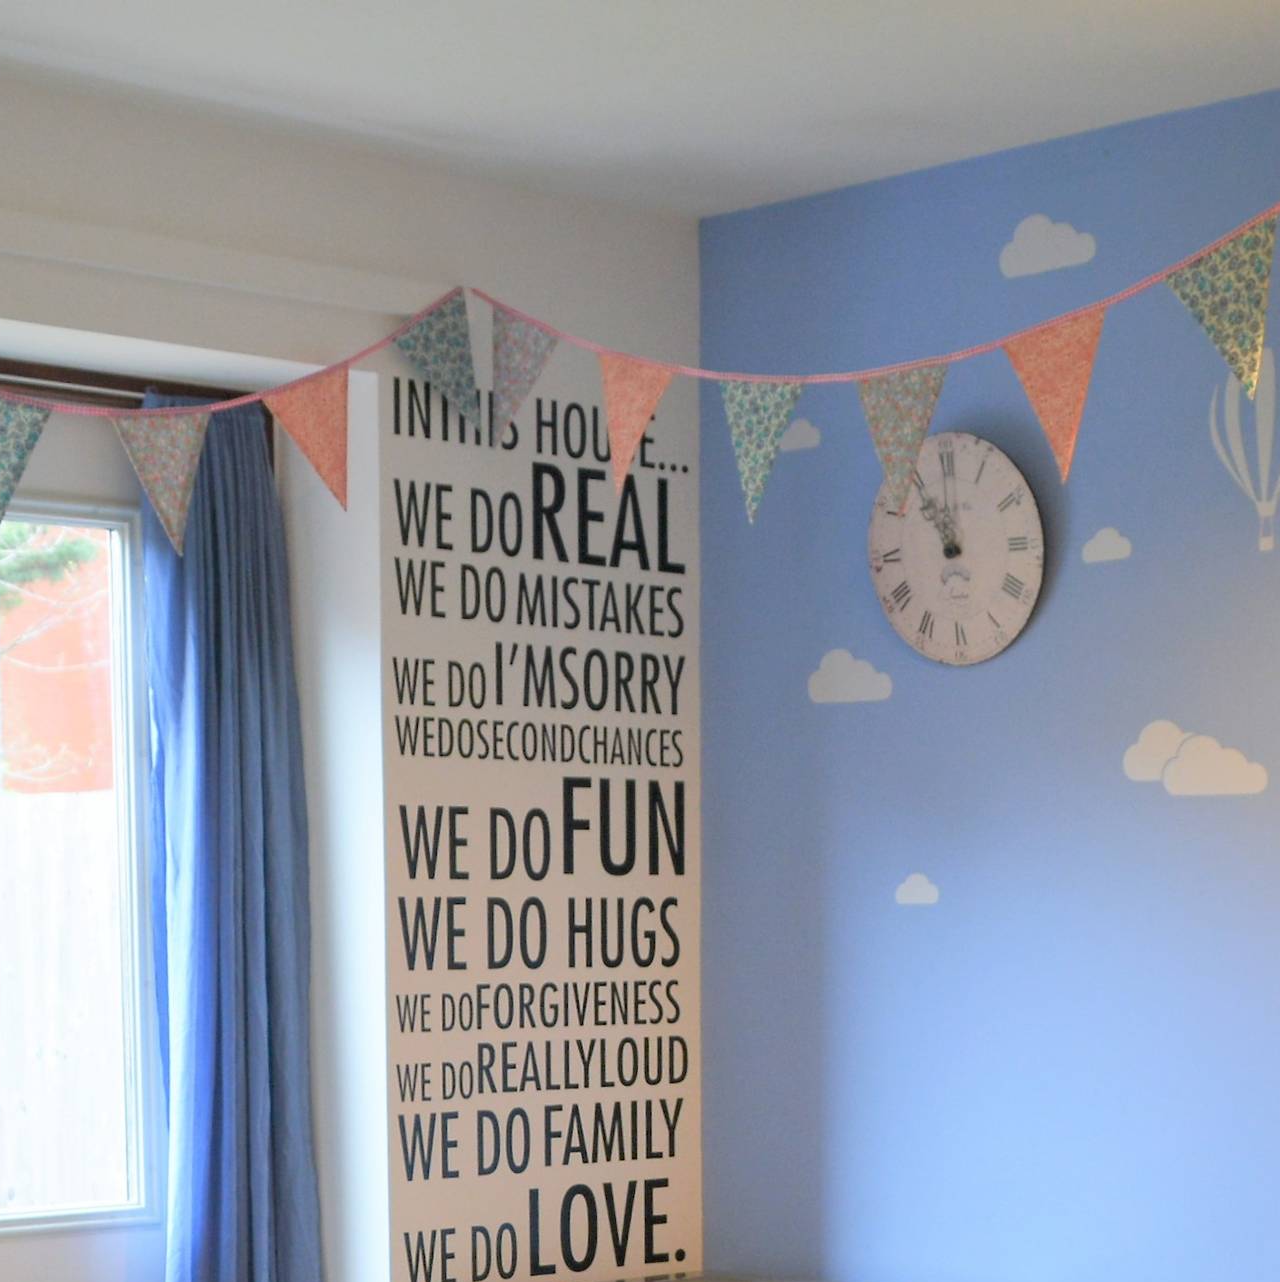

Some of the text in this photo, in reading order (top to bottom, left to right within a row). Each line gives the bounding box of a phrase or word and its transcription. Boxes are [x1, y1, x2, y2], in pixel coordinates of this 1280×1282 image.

[535, 397, 689, 475] HOUE...
[394, 461, 686, 575] WE DO REAL
[394, 556, 685, 639] WE DO MISTAKES
[392, 656, 436, 707] WE
[447, 660, 487, 710] DO
[398, 776, 685, 882] WE DO FUN
[397, 896, 681, 972] WE DO HUGS
[395, 979, 681, 1033] WE DO FORGIVENESS
[396, 1062, 432, 1103] WE
[441, 1060, 474, 1101] DO
[397, 1097, 684, 1182] WE DO FAMILY
[471, 1222, 518, 1282] DO
[528, 1177, 686, 1277] LOVE.
